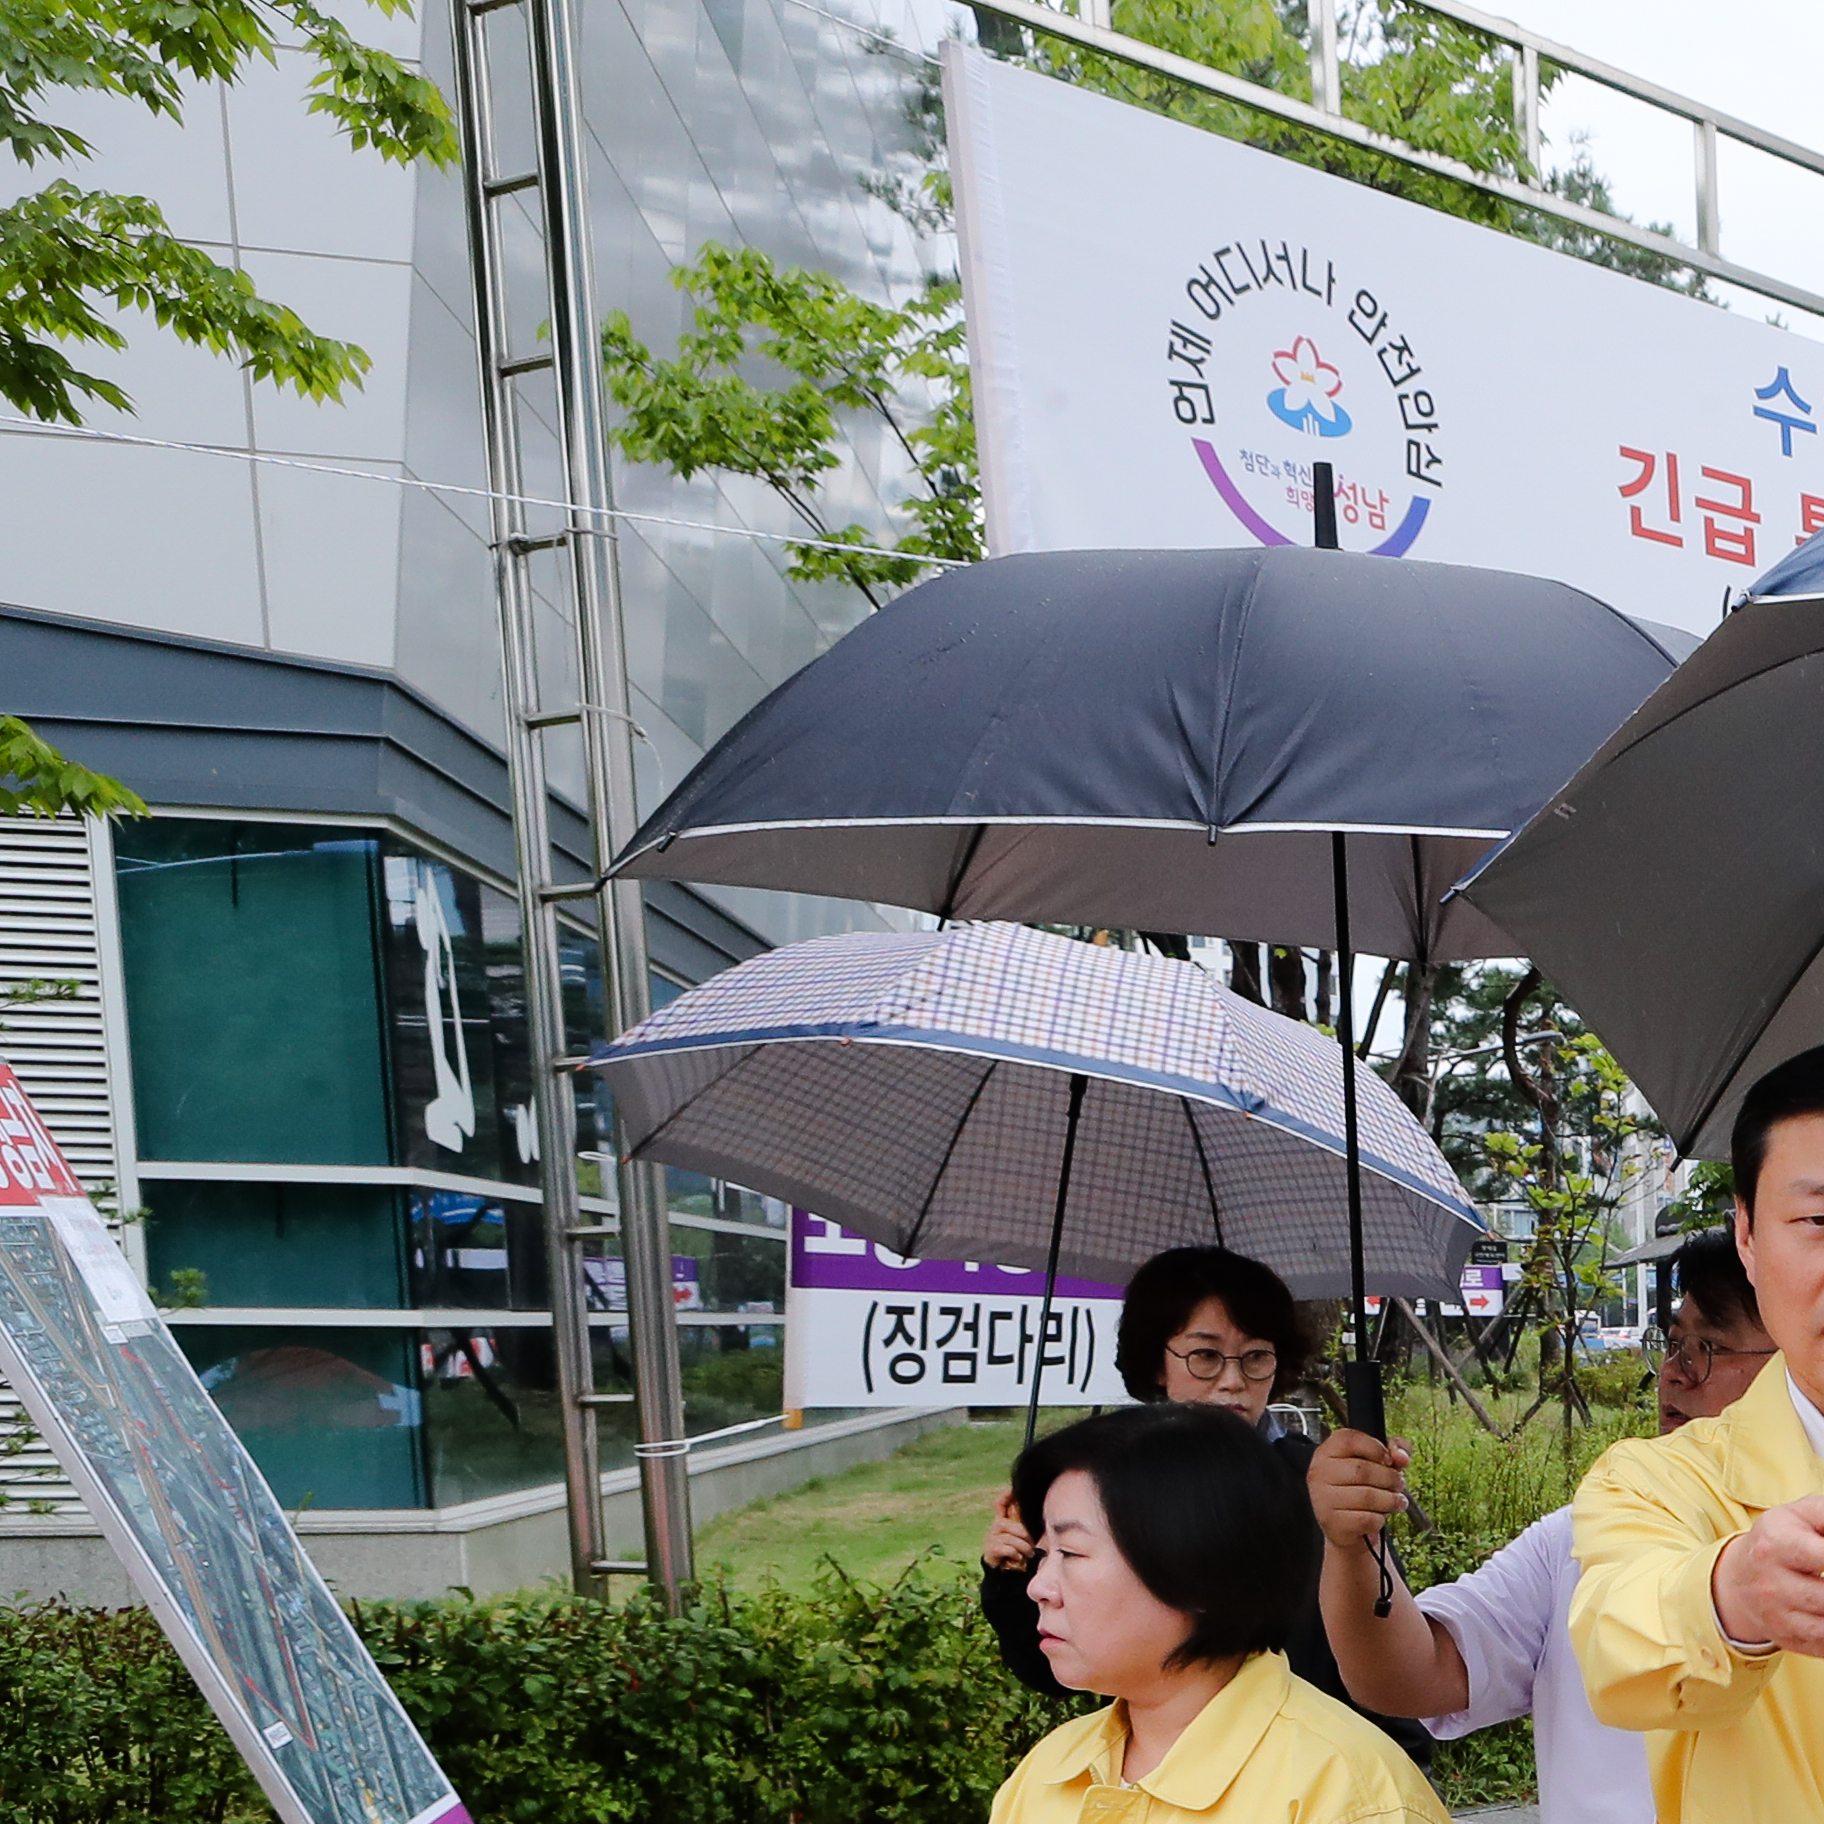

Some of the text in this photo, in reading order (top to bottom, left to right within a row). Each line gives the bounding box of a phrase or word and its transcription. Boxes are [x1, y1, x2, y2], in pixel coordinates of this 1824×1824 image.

[1186, 238, 1337, 321] 어디서나
[1167, 318, 1216, 426] 언제
[1239, 447, 1315, 487] 첨단과 혁신
[1286, 486, 1315, 512] 희망
[1333, 473, 1390, 532] 성남
[1618, 444, 1762, 568] 긴급
[862, 1299, 1095, 1394] (징검다리)
